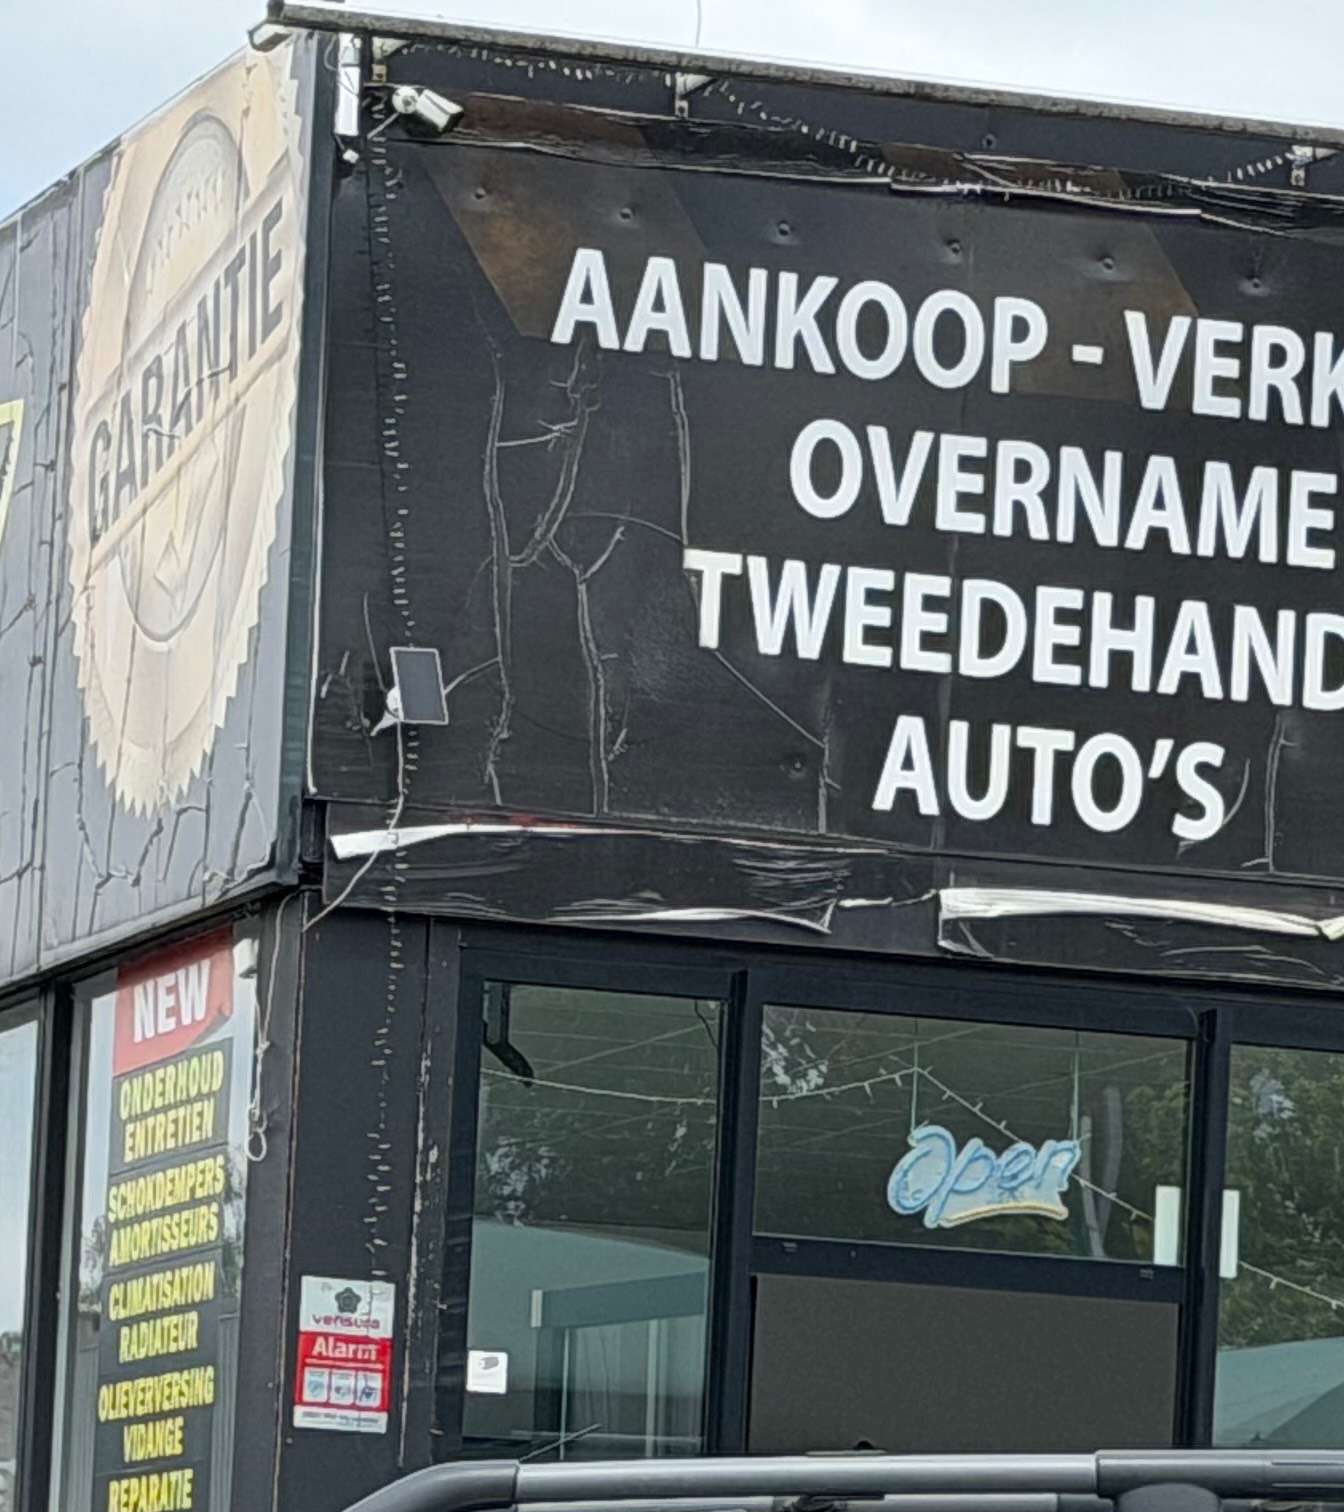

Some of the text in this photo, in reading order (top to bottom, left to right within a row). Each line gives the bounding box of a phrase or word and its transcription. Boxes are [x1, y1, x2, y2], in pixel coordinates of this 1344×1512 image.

[550, 248, 1047, 394] AANKOOP
[88, 195, 284, 551] GARANTIE
[789, 418, 1338, 570] OVERNAME
[871, 715, 1227, 840] AUTO'S
[133, 958, 211, 1044] NEW
[119, 1050, 224, 1121] ONDERHOUD
[124, 1097, 215, 1164] ENTRETIEN
[108, 1154, 225, 1223] SCHOKDEMPERS
[889, 1126, 1081, 1229] Open
[109, 1202, 219, 1267] AMORTISSEURS
[109, 1261, 216, 1321] CLIMATISATION
[119, 1310, 198, 1364] RADIATEUR
[311, 1336, 378, 1362] Alarm
[123, 1416, 184, 1463] VIDANGE
